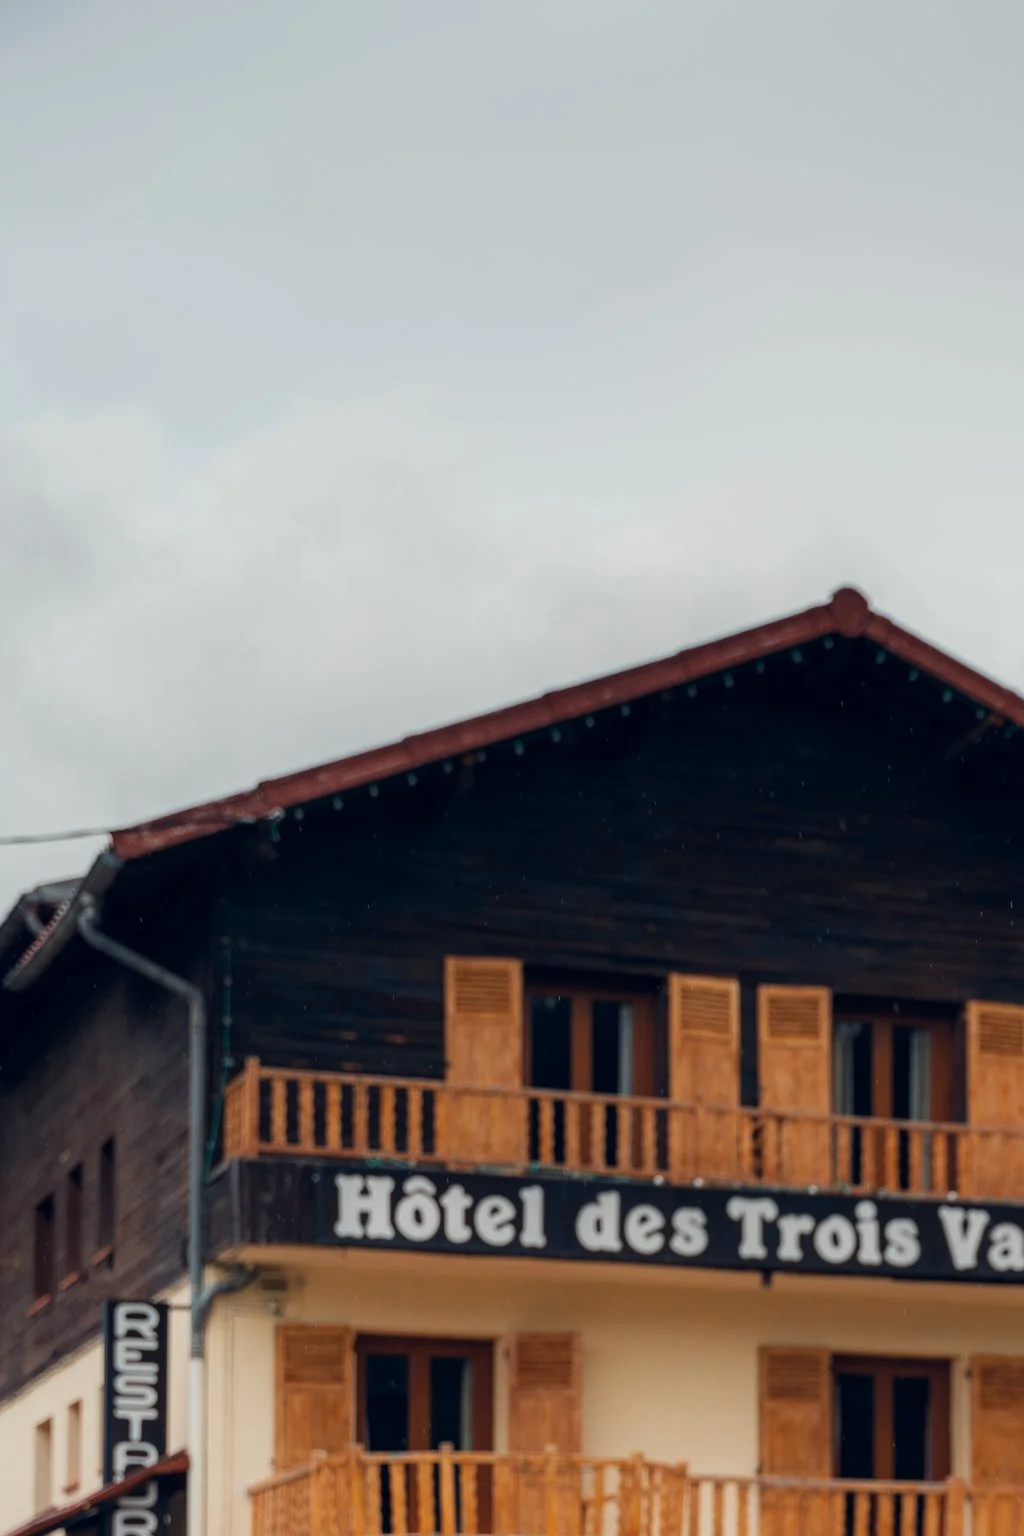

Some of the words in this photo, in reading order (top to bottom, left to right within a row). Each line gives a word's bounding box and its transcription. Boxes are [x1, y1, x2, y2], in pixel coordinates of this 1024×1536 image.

[334, 1174, 548, 1249] Hôtel
[576, 1190, 710, 1257] des
[727, 1196, 921, 1268] Trois
